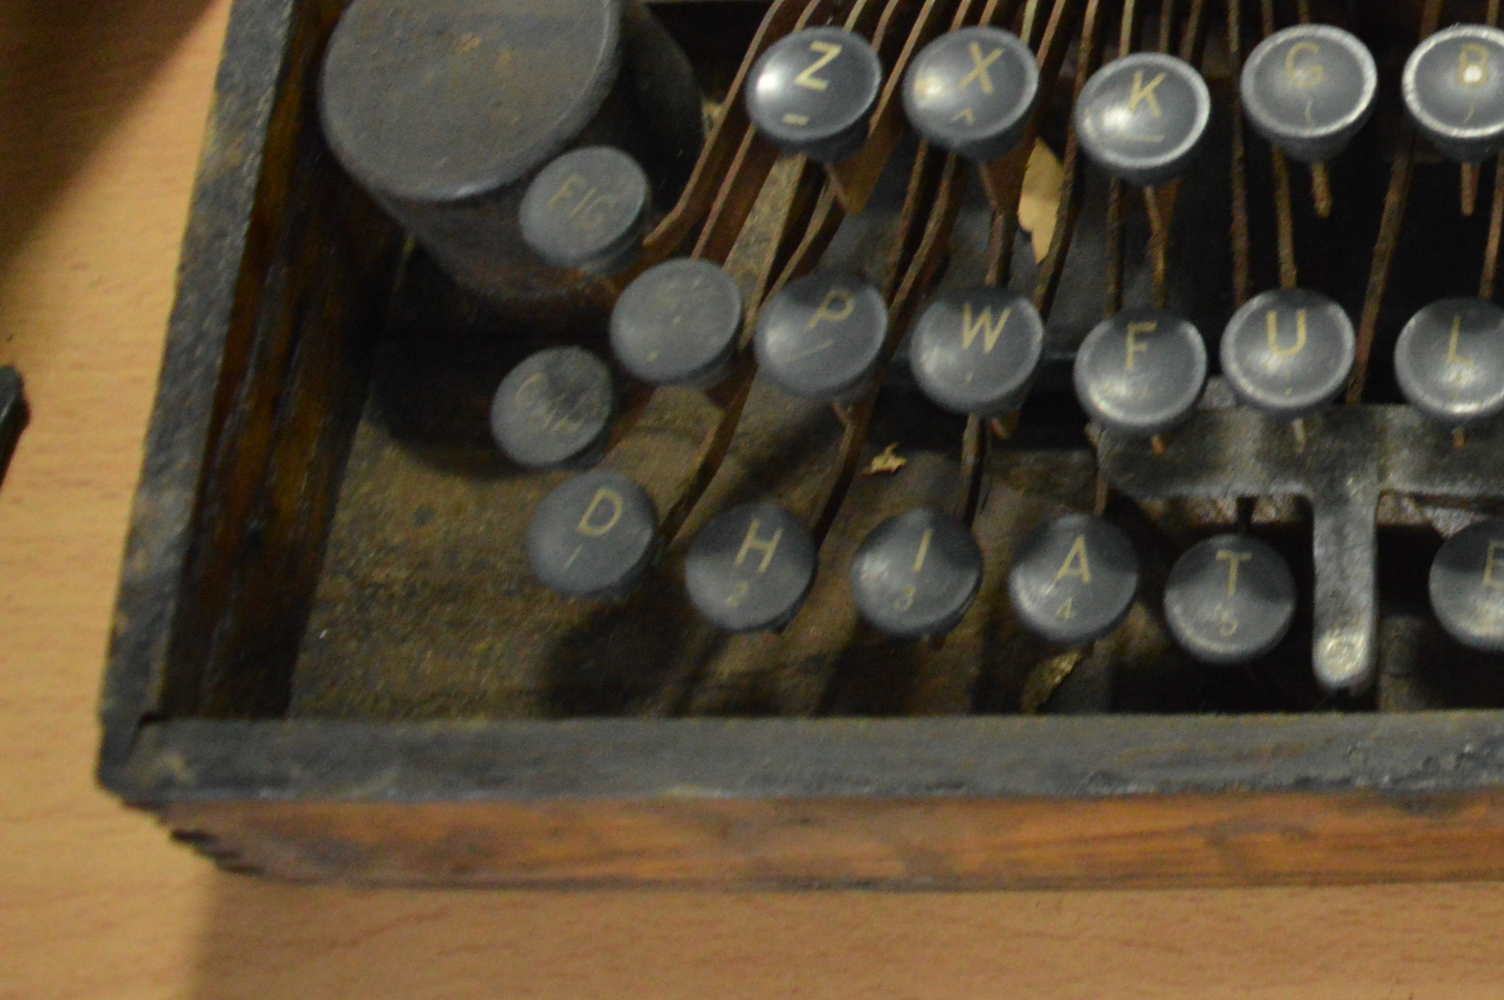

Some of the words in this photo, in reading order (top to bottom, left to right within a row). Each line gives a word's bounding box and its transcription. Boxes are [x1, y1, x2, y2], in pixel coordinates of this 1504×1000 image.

[794, 40, 842, 91] Z
[959, 41, 1004, 94] X
[1284, 42, 1325, 90] G
[1128, 71, 1166, 118] K
[805, 290, 854, 330] P
[962, 304, 1012, 353] W
[1266, 309, 1307, 357] U
[1126, 321, 1156, 369] F
[1447, 316, 1474, 365] L
[577, 487, 623, 537] D
[735, 517, 784, 574] H
[1055, 534, 1092, 584] A
[726, 580, 749, 607] 2
[1216, 549, 1251, 596] T
